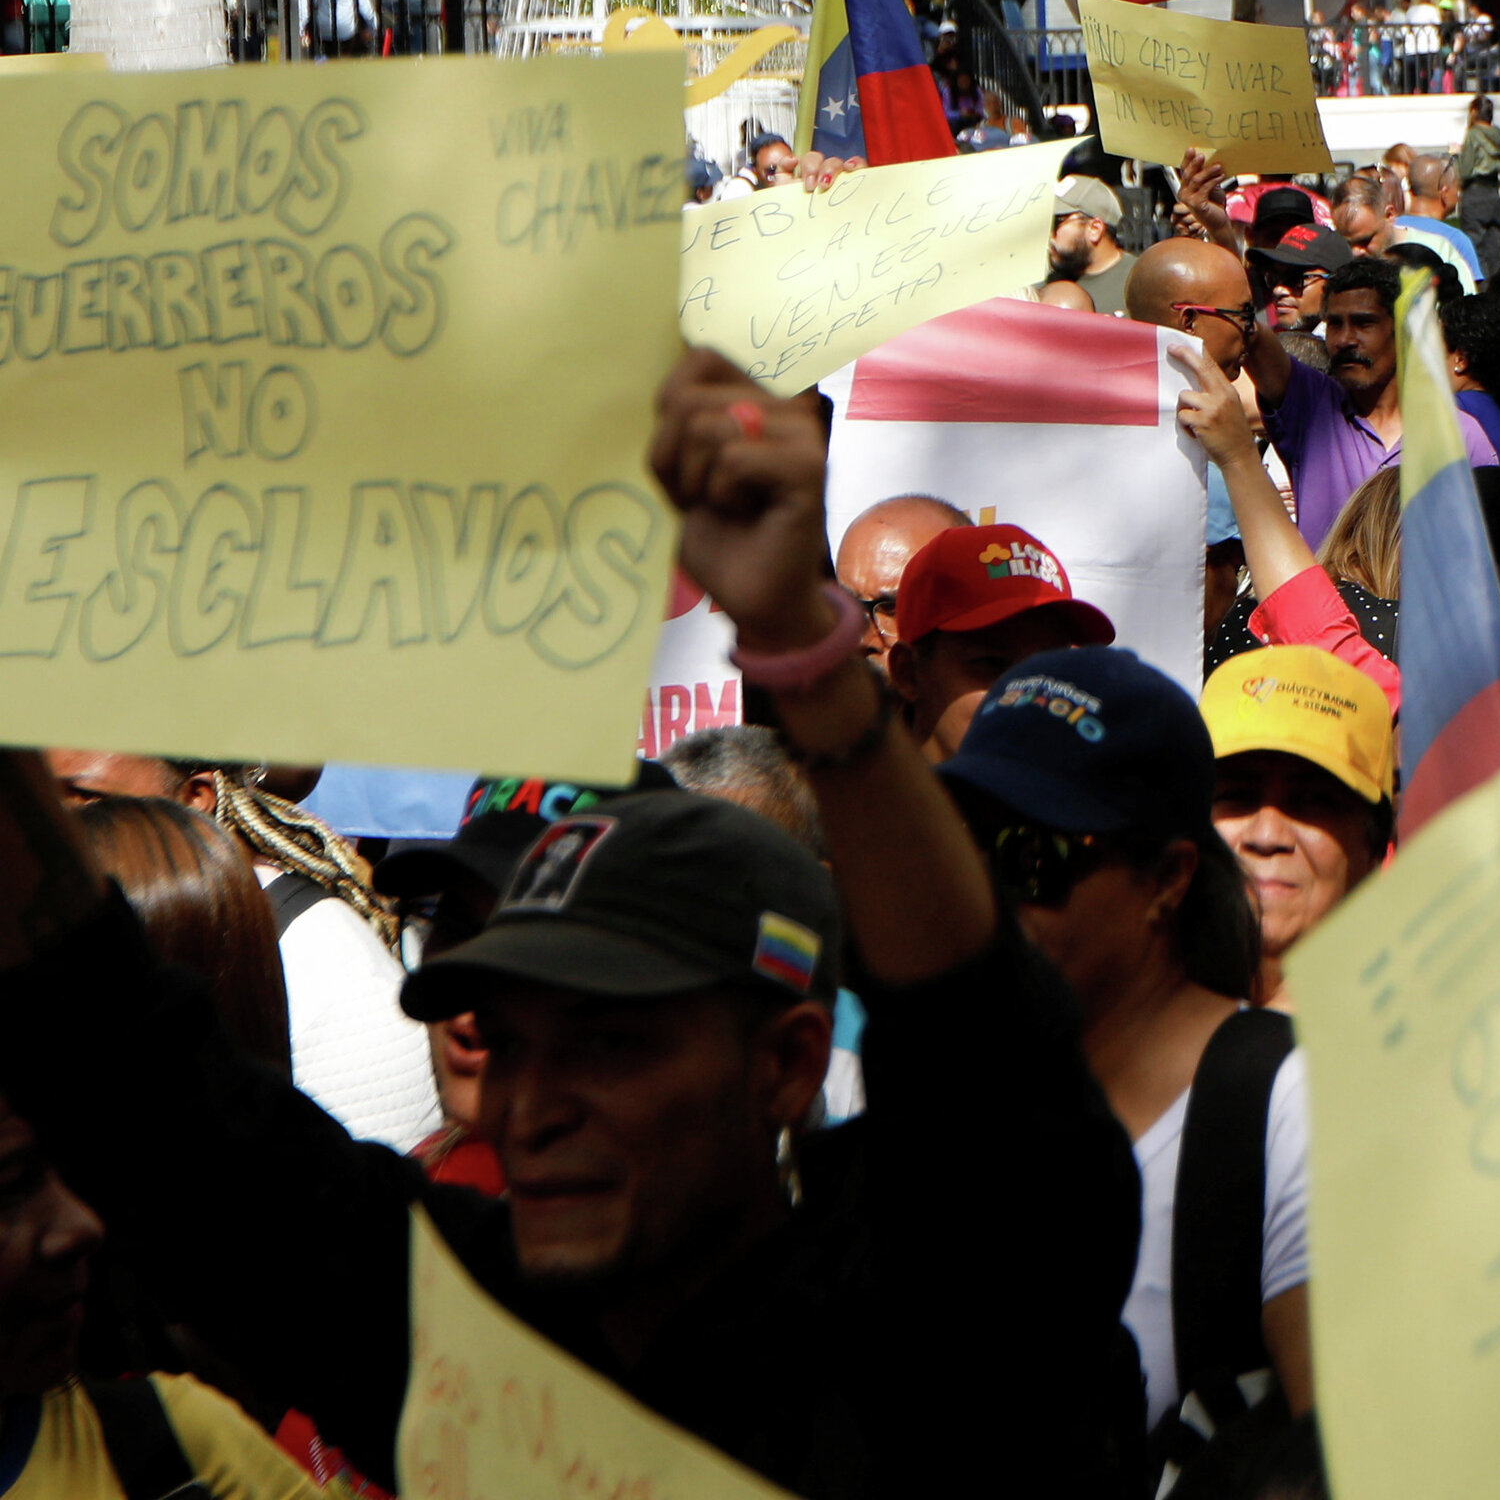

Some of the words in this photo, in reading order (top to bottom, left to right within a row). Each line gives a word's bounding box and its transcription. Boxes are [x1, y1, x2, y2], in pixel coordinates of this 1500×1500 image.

[1113, 90, 1138, 124] IN
[1138, 36, 1211, 91] CRAZY
[1225, 61, 1292, 96] WAR
[48, 95, 367, 250] SOMOS
[0, 211, 454, 366] UERREROS
[178, 360, 316, 470] NO
[0, 474, 667, 671] ESCLAVOS
